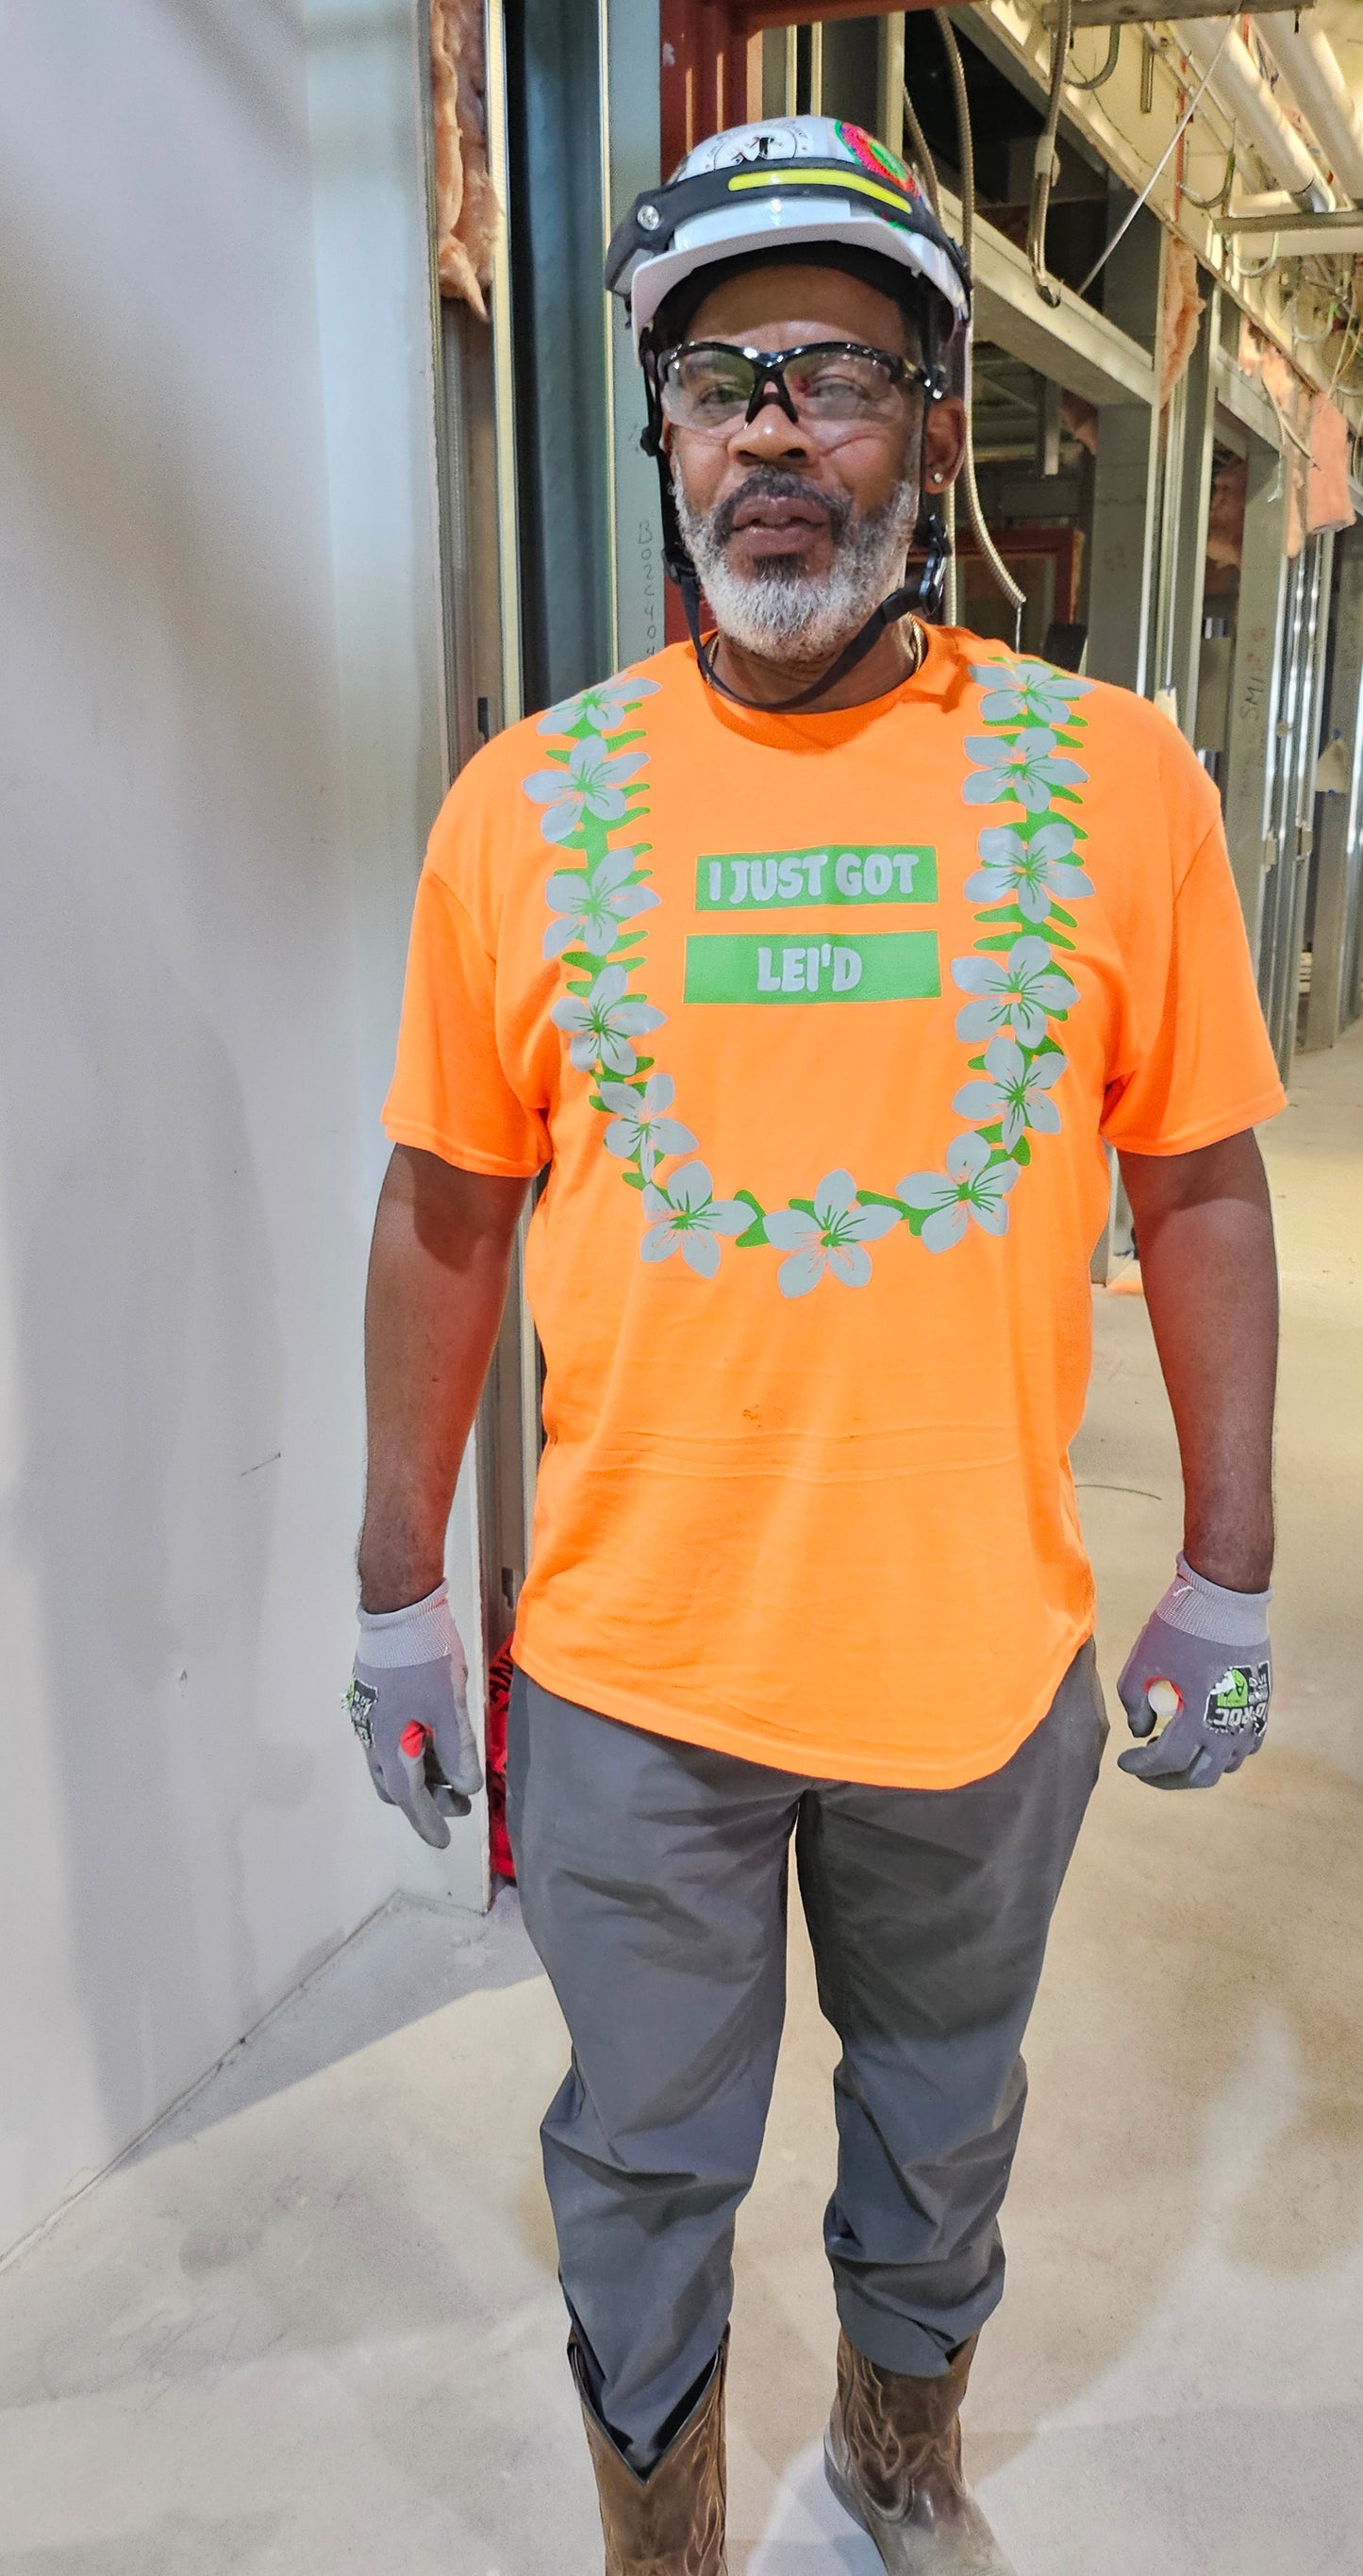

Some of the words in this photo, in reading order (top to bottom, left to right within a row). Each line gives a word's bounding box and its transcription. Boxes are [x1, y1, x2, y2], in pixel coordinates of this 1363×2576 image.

[708, 860, 723, 901] I
[729, 854, 829, 904] JUST
[835, 853, 920, 897] GOT
[756, 942, 863, 991] LEI'D
